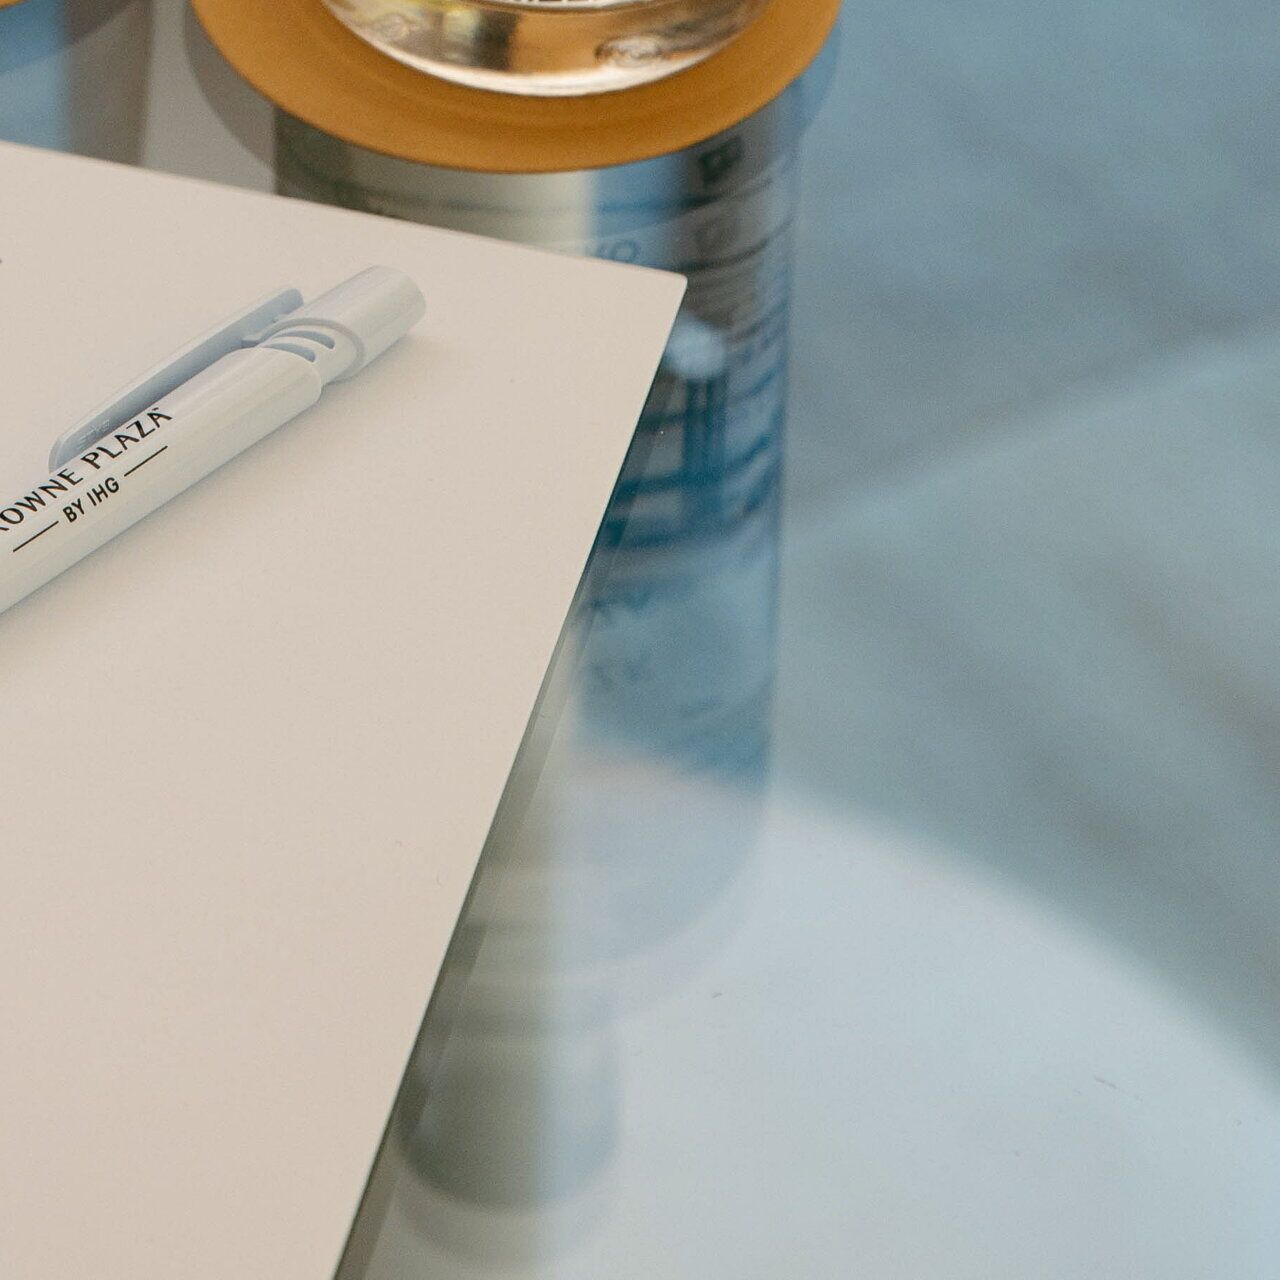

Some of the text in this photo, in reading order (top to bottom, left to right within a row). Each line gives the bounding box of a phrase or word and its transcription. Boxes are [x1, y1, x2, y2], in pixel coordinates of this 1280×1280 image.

[80, 409, 173, 470] PLAZA
[62, 476, 120, 523] BY IHG
